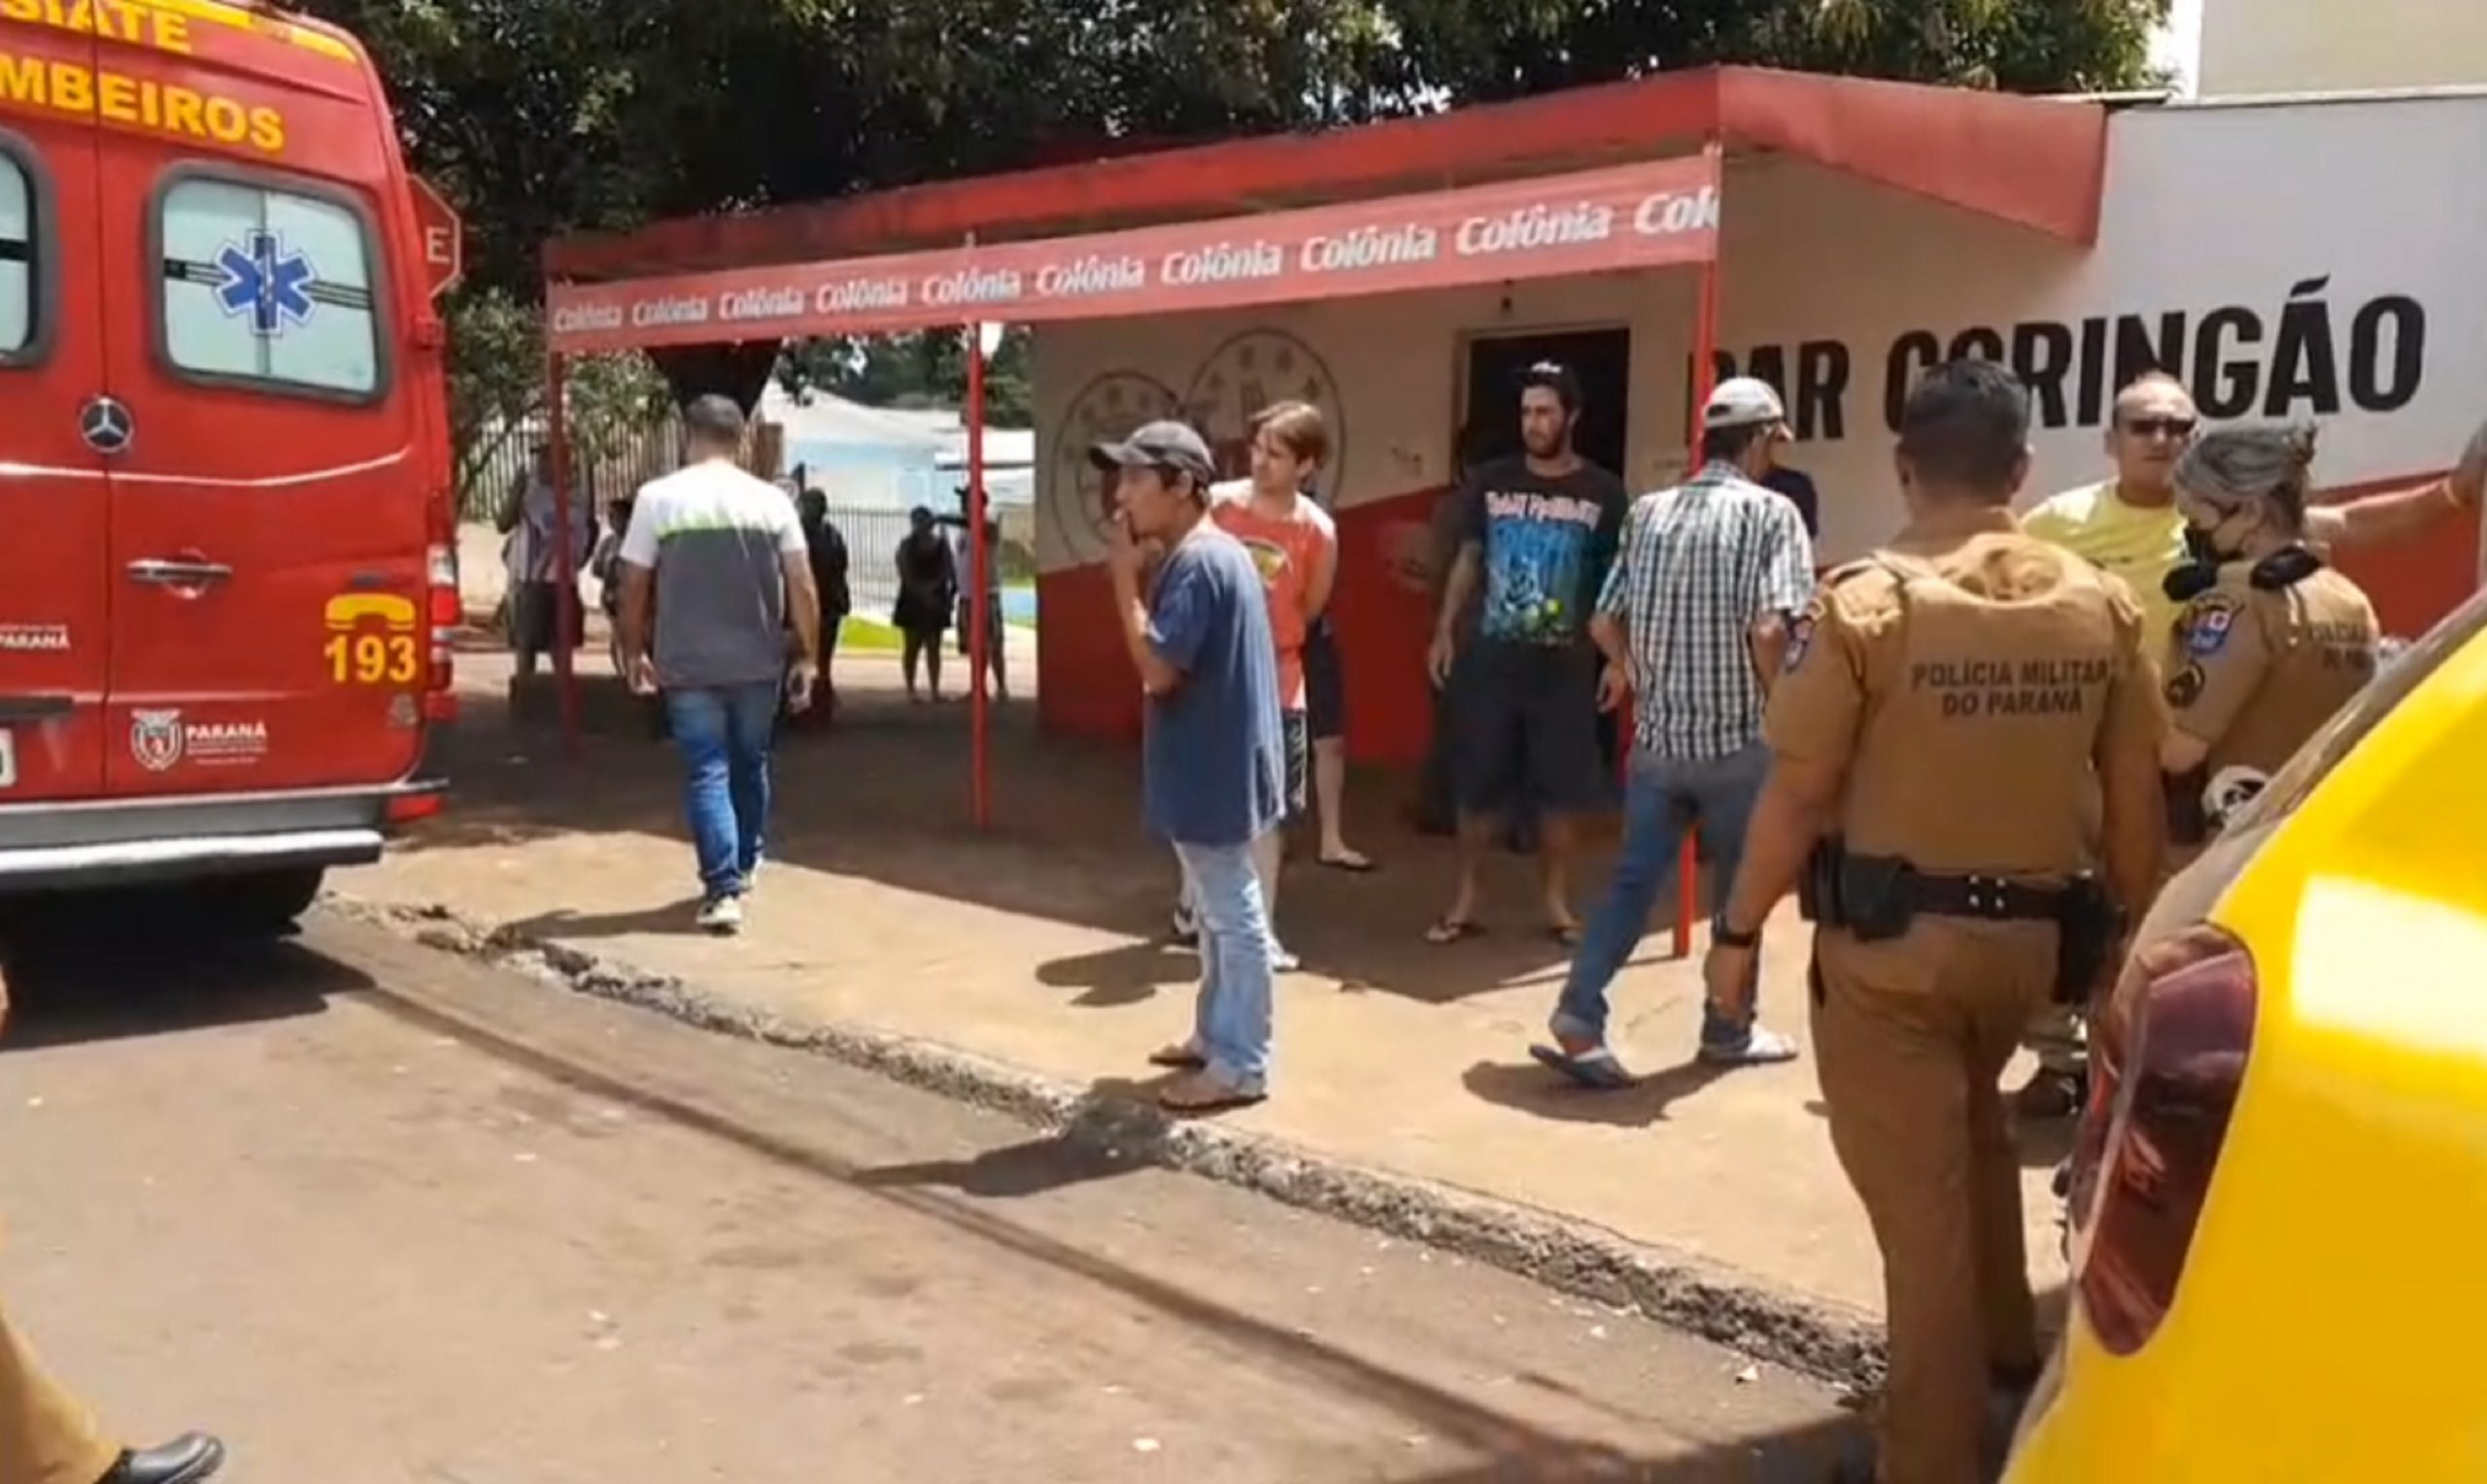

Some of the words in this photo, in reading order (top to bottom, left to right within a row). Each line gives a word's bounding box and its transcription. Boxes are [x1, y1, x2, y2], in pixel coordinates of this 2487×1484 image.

[719, 288, 803, 320] Colônia
[816, 280, 907, 313] Colônia
[922, 267, 1020, 306] Colônia
[1036, 254, 1144, 293] Colônia
[1161, 241, 1282, 284] Colônia
[1300, 223, 1436, 271] Colônia
[1456, 201, 1613, 254] Colônia
[324, 634, 417, 682] 193
[1911, 658, 2013, 692] POLÍCIA
[2021, 658, 2109, 687] MILITAR
[1943, 691, 1980, 720] DO
[1988, 686, 2083, 717] PARANÁ
[186, 720, 267, 739] PARANÁ
